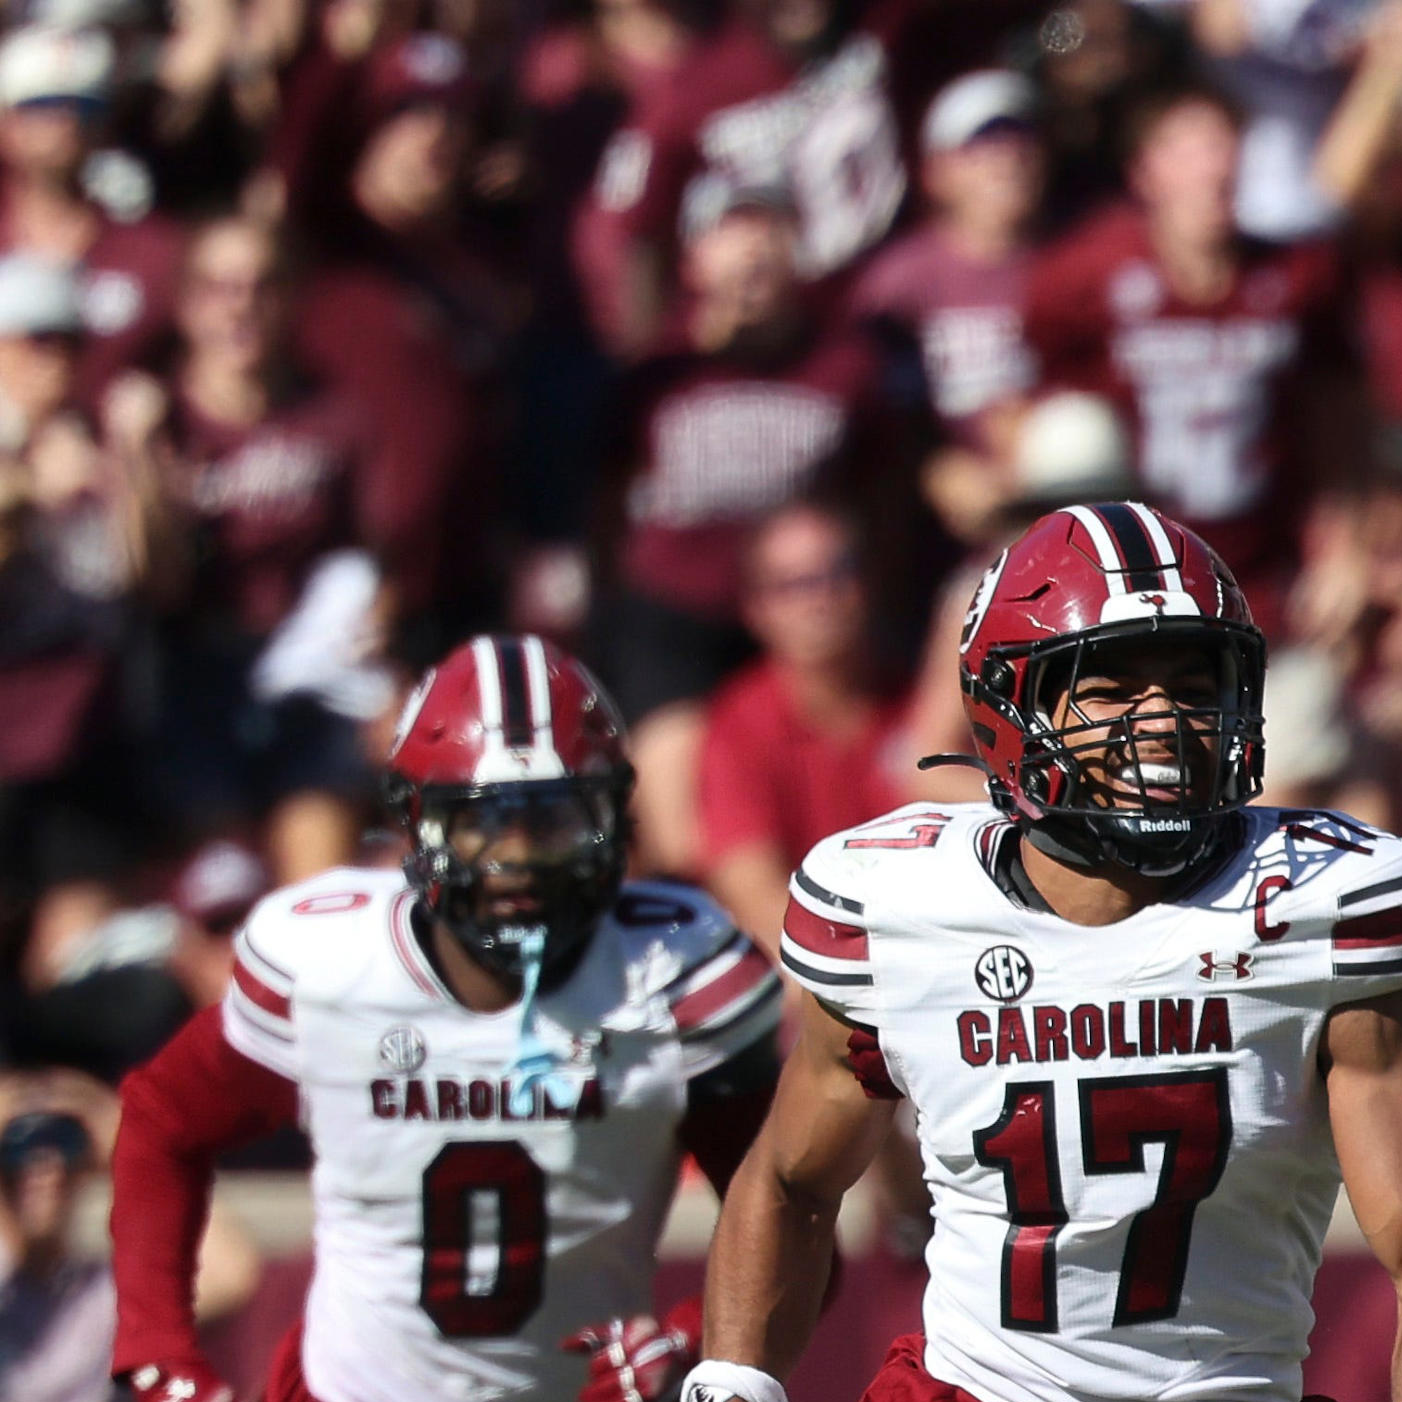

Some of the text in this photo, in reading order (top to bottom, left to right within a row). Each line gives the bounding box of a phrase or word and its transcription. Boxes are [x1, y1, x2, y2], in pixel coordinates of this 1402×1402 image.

[1139, 820, 1191, 833] Riddell
[291, 891, 371, 916] 0
[1254, 875, 1293, 942] C
[977, 947, 1032, 1001] SEC
[957, 998, 1233, 1068] CAROLINA
[973, 1069, 1233, 1333] 17
[419, 1140, 547, 1338] 0
